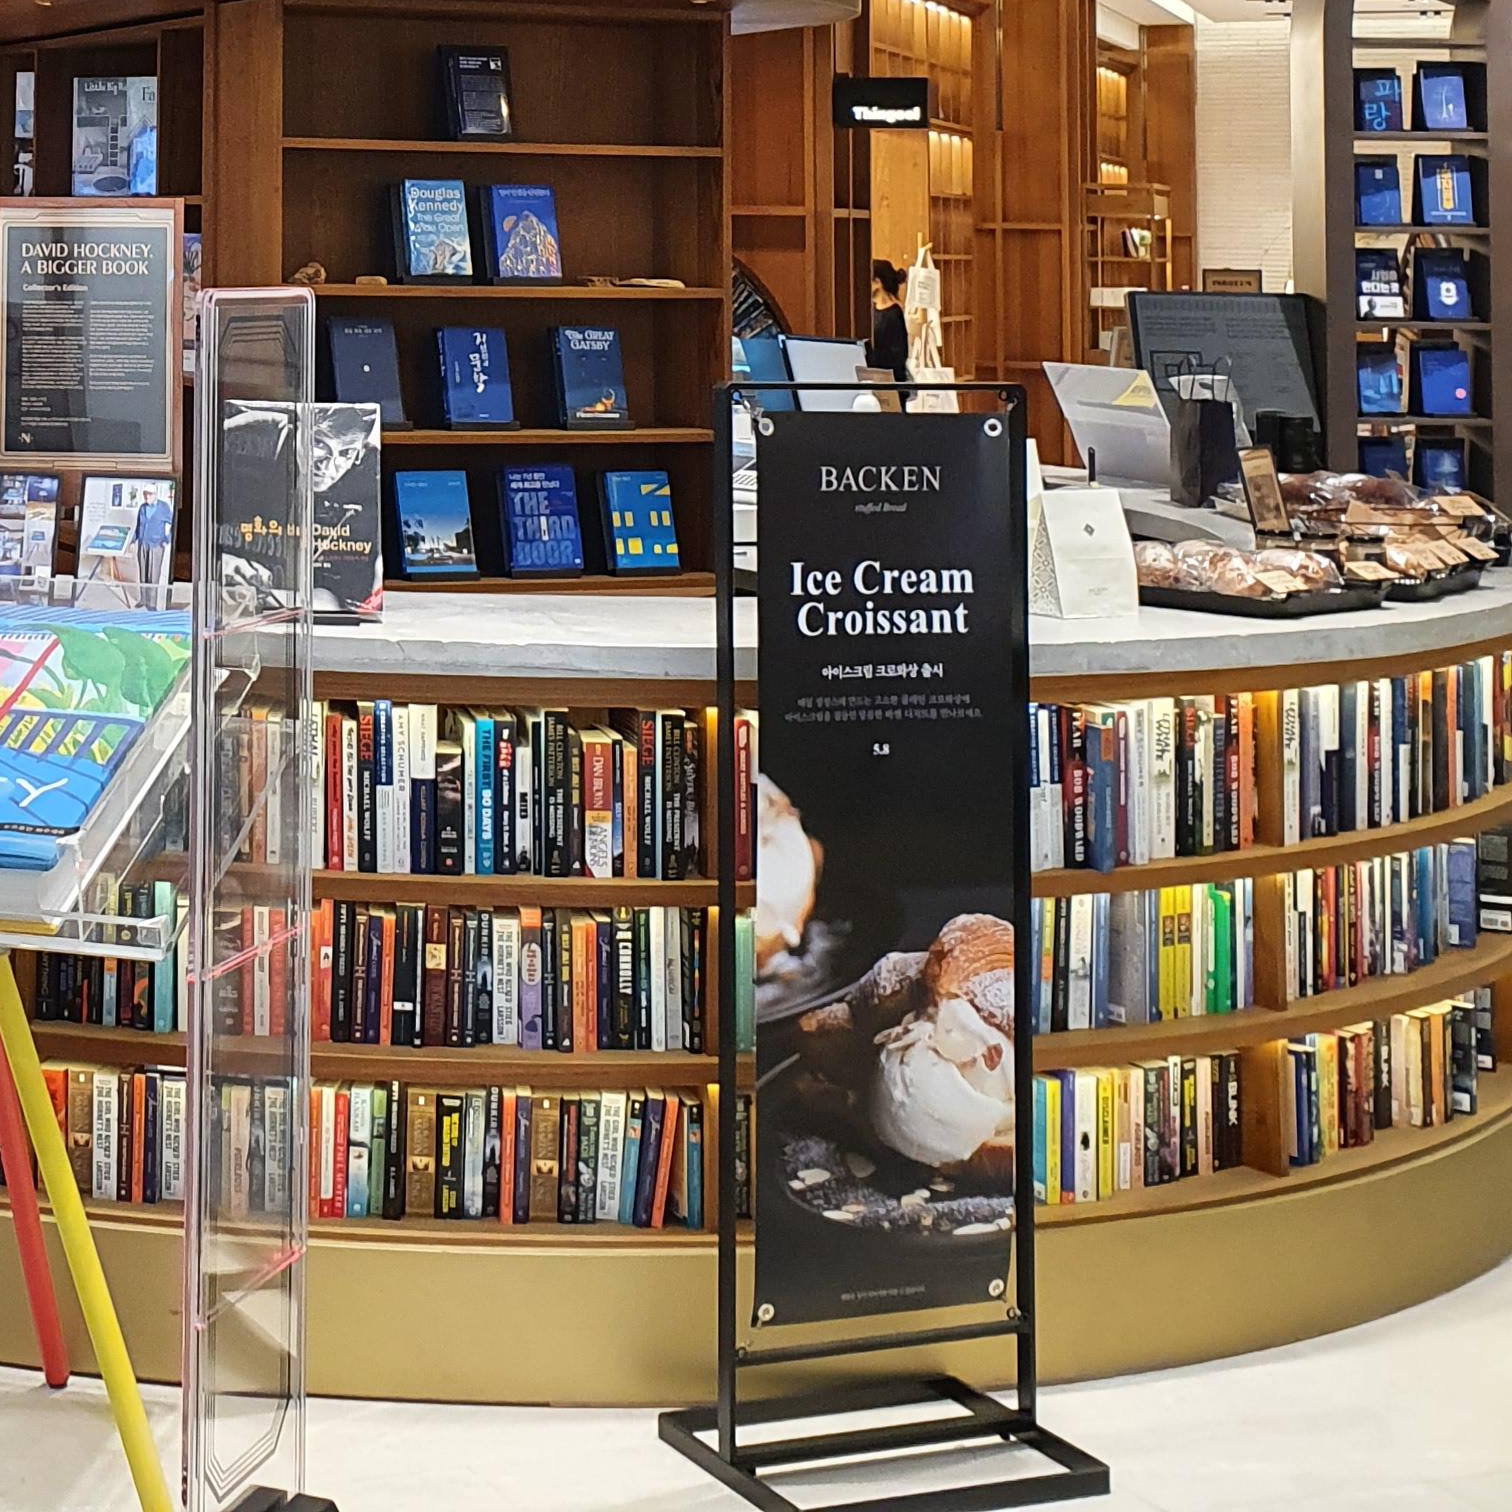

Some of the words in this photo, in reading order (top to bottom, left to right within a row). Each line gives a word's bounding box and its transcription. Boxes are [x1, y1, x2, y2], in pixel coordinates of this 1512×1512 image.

[1375, 78, 1400, 101] 파
[1365, 103, 1391, 130] 랑
[410, 187, 460, 200] Douglas
[410, 200, 463, 213] Kennedy
[22, 243, 68, 258] DAVID
[20, 261, 32, 275] A
[37, 260, 96, 275] BIGGER
[102, 261, 149, 276] BOOK
[570, 339, 610, 351] GATSBY
[820, 466, 941, 492] BACKEN
[514, 491, 550, 515] THE
[313, 524, 350, 539] David
[513, 515, 576, 541] THIRD
[313, 539, 372, 554] Hockney
[517, 541, 573, 566] DOOR
[790, 562, 842, 595] Ice
[854, 561, 974, 596] Cream
[798, 601, 969, 636] Croissant
[822, 664, 873, 679] 아이스크림
[921, 663, 943, 678] 출시
[359, 715, 373, 760] SIEGE
[482, 729, 491, 752] THE
[548, 717, 556, 740] JAMES
[1073, 712, 1082, 747] FEAR
[1155, 719, 1163, 760] WHITE
[642, 720, 654, 766] SIEGE
[397, 741, 405, 792] SCHUMER
[482, 755, 491, 787] FIRST
[548, 742, 556, 786] PATTERSON
[593, 756, 604, 777] DAN
[1074, 769, 1082, 793] BOB
[482, 790, 491, 806] 90
[482, 808, 491, 840] DAYS
[1074, 796, 1083, 861] WOODWARD
[597, 827, 607, 868] ANGELS
[618, 942, 632, 994] CONNOLLY
[95, 1087, 104, 1098] THE
[1228, 1082, 1238, 1125] BLINK
[95, 1100, 104, 1132] HORNET'S
[610, 1106, 619, 1117] THE
[610, 1119, 619, 1135] GIRL
[95, 1134, 104, 1149] NEST
[610, 1137, 619, 1152] WHO
[610, 1153, 619, 1178] KICKED
